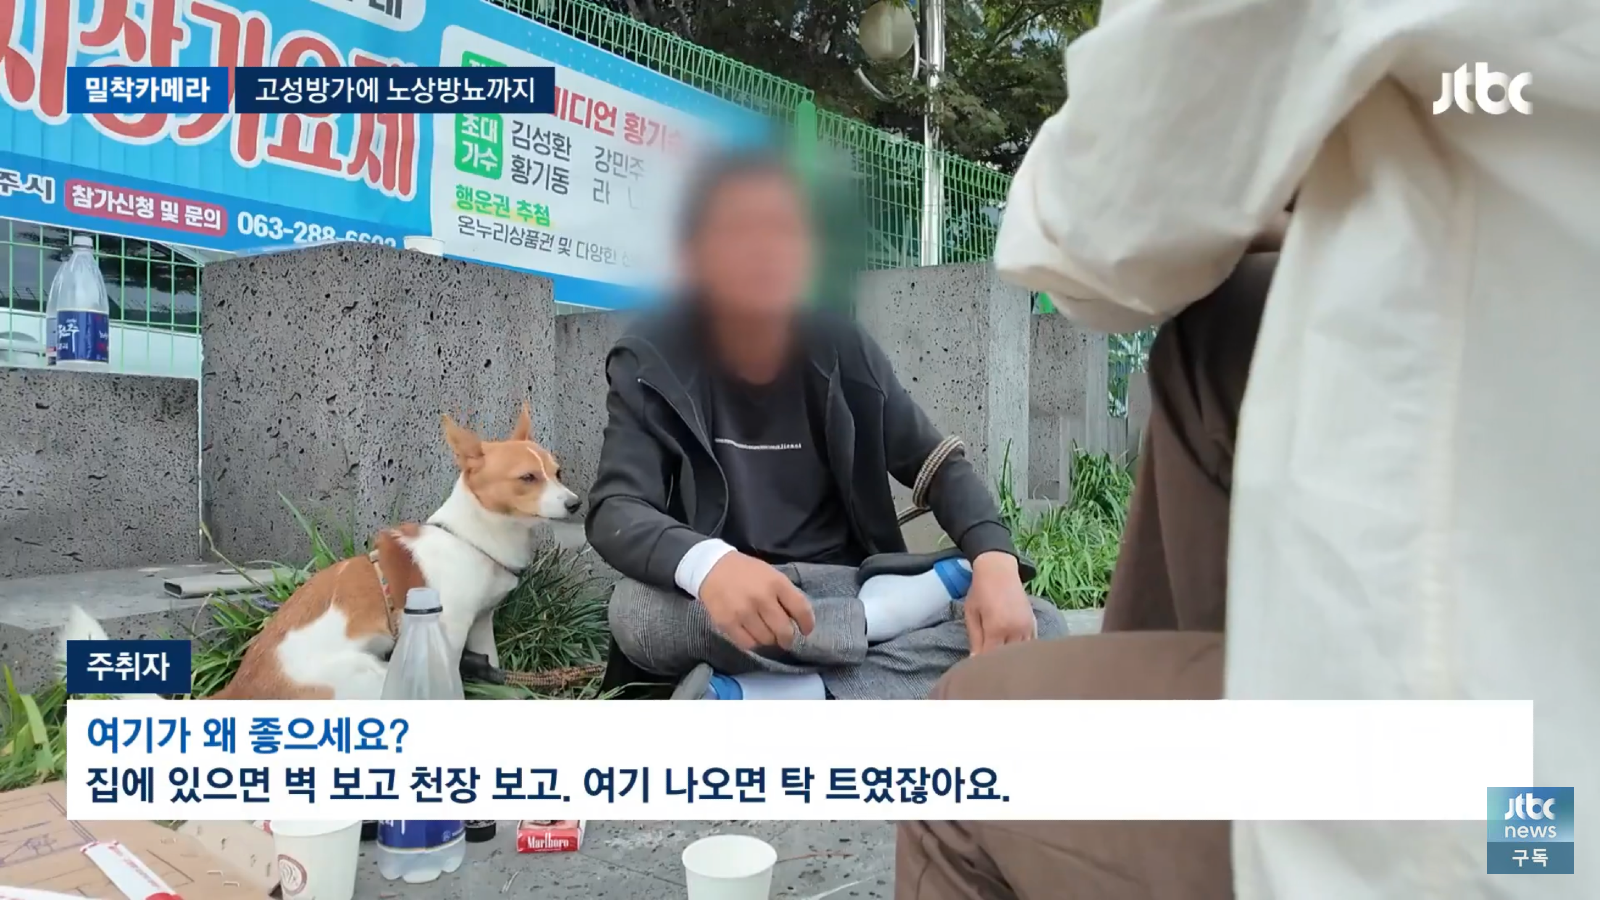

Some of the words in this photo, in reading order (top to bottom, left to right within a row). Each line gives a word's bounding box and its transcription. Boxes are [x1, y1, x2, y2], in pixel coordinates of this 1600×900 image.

[461, 114, 498, 144] 초대
[461, 141, 498, 171] 가수
[511, 120, 572, 162] 김성환
[594, 146, 648, 181] 강민주
[511, 155, 570, 195] 황기동
[72, 184, 155, 219] 참가신청
[161, 200, 179, 223] 및
[184, 206, 221, 230] 문의
[455, 184, 511, 219] 행운권
[516, 199, 551, 227] 추첨
[457, 215, 556, 252] 온누리상품권
[558, 237, 573, 257] 및
[576, 240, 618, 266] 다양한
[527, 832, 570, 849] Marlboro
